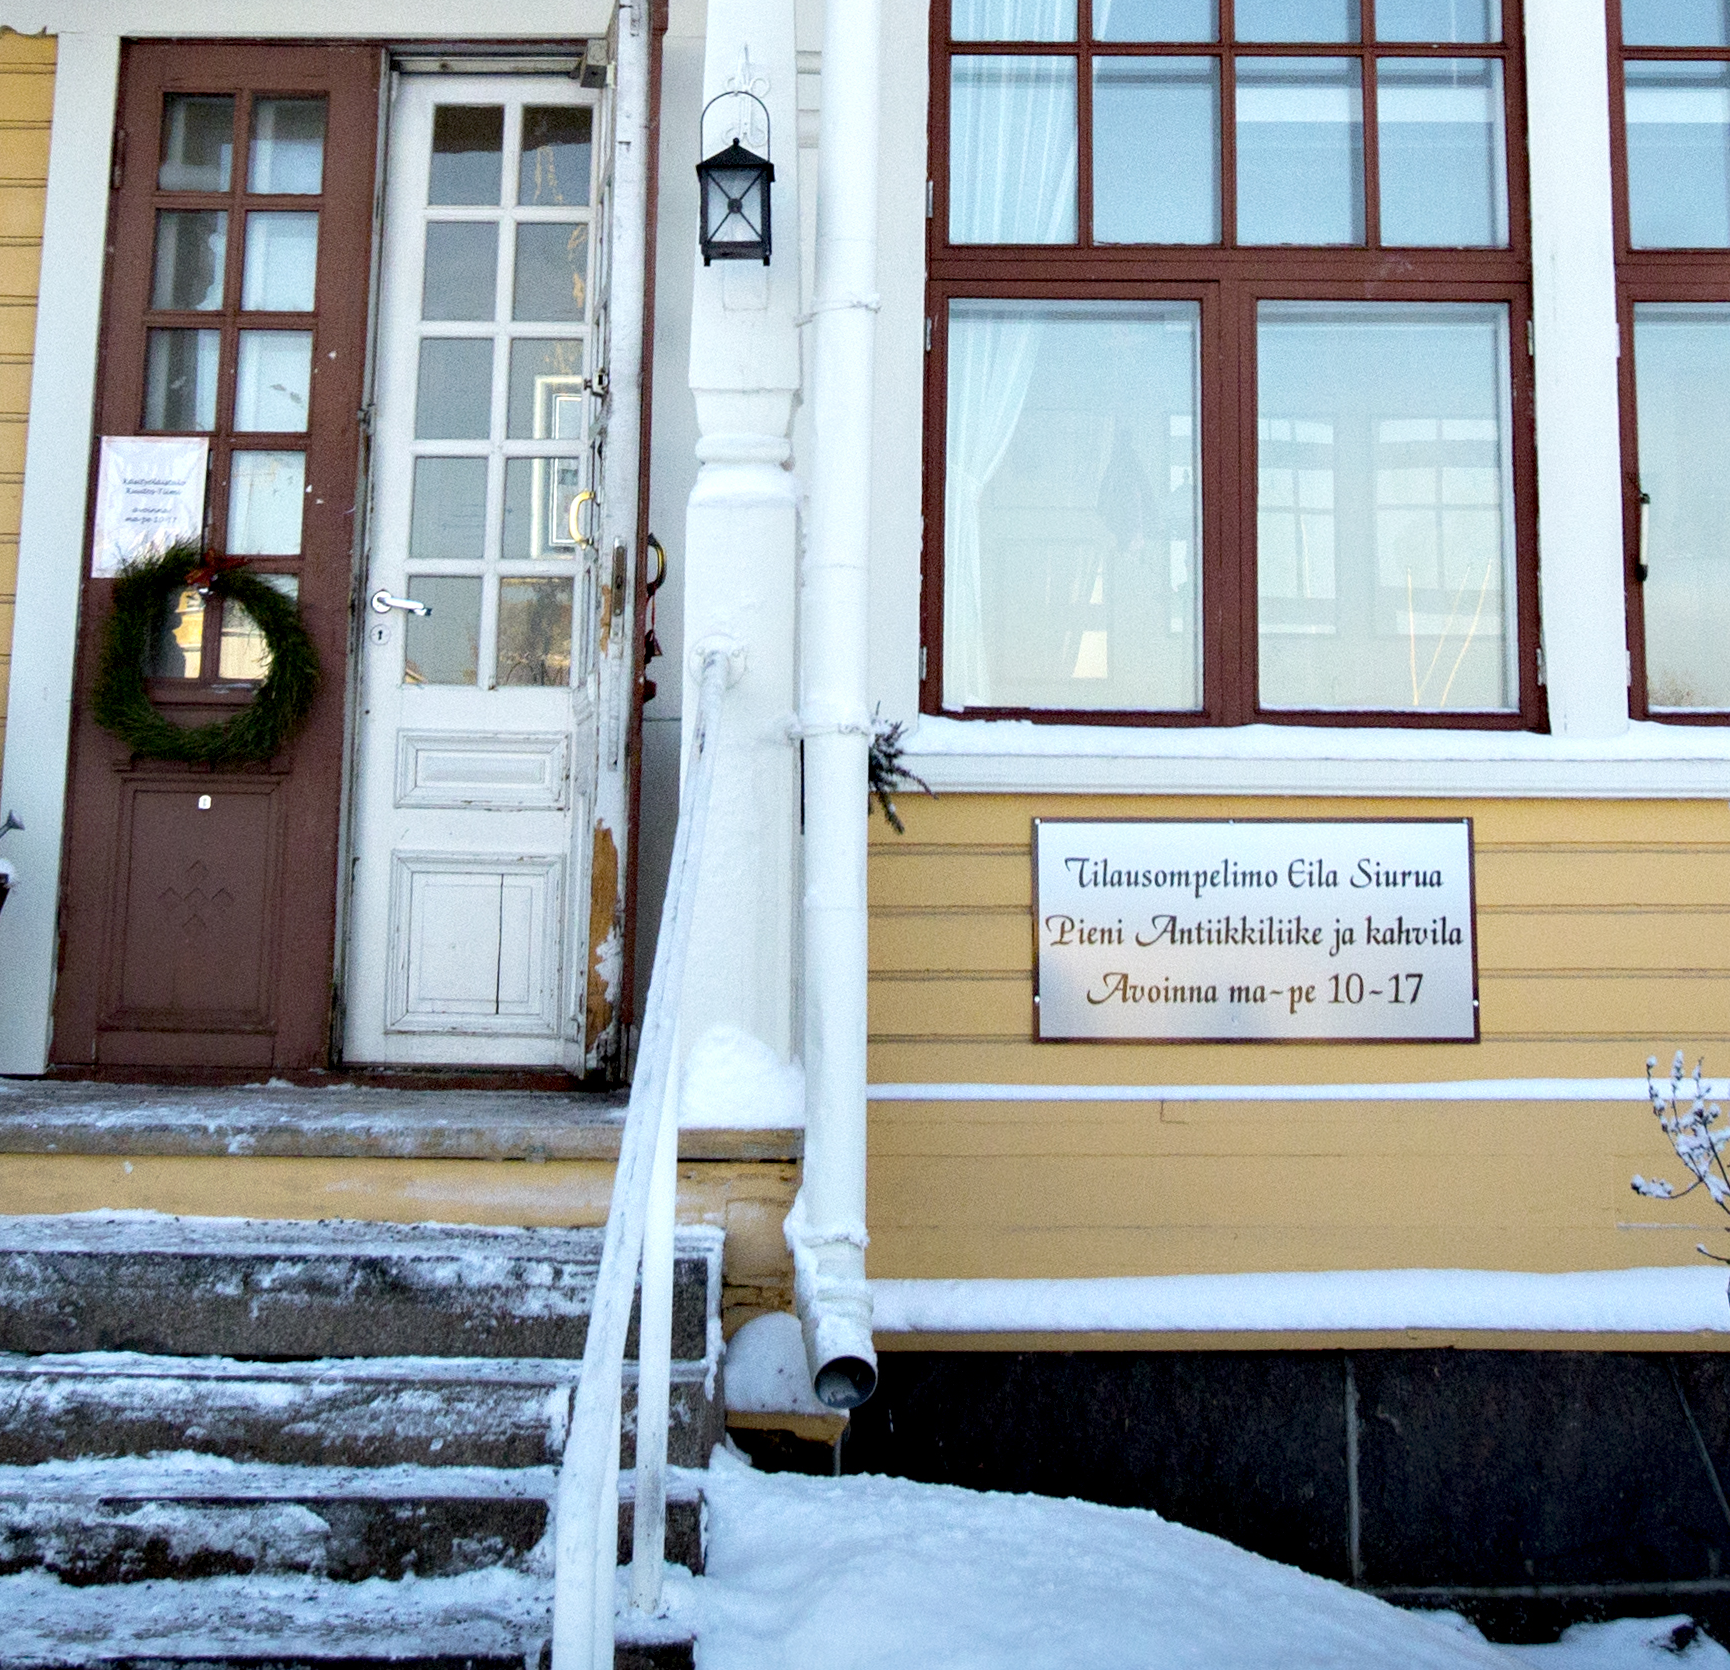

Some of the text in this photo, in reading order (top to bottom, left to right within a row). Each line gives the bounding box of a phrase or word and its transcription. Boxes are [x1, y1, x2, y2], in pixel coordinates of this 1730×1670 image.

[1064, 856, 1444, 898] Tilausompelimo Eila Siurua
[1045, 914, 1464, 957] Pieni Antiikkiliike ja kahvila
[1086, 971, 1424, 1015] Avoinna ma-pe 10-17
